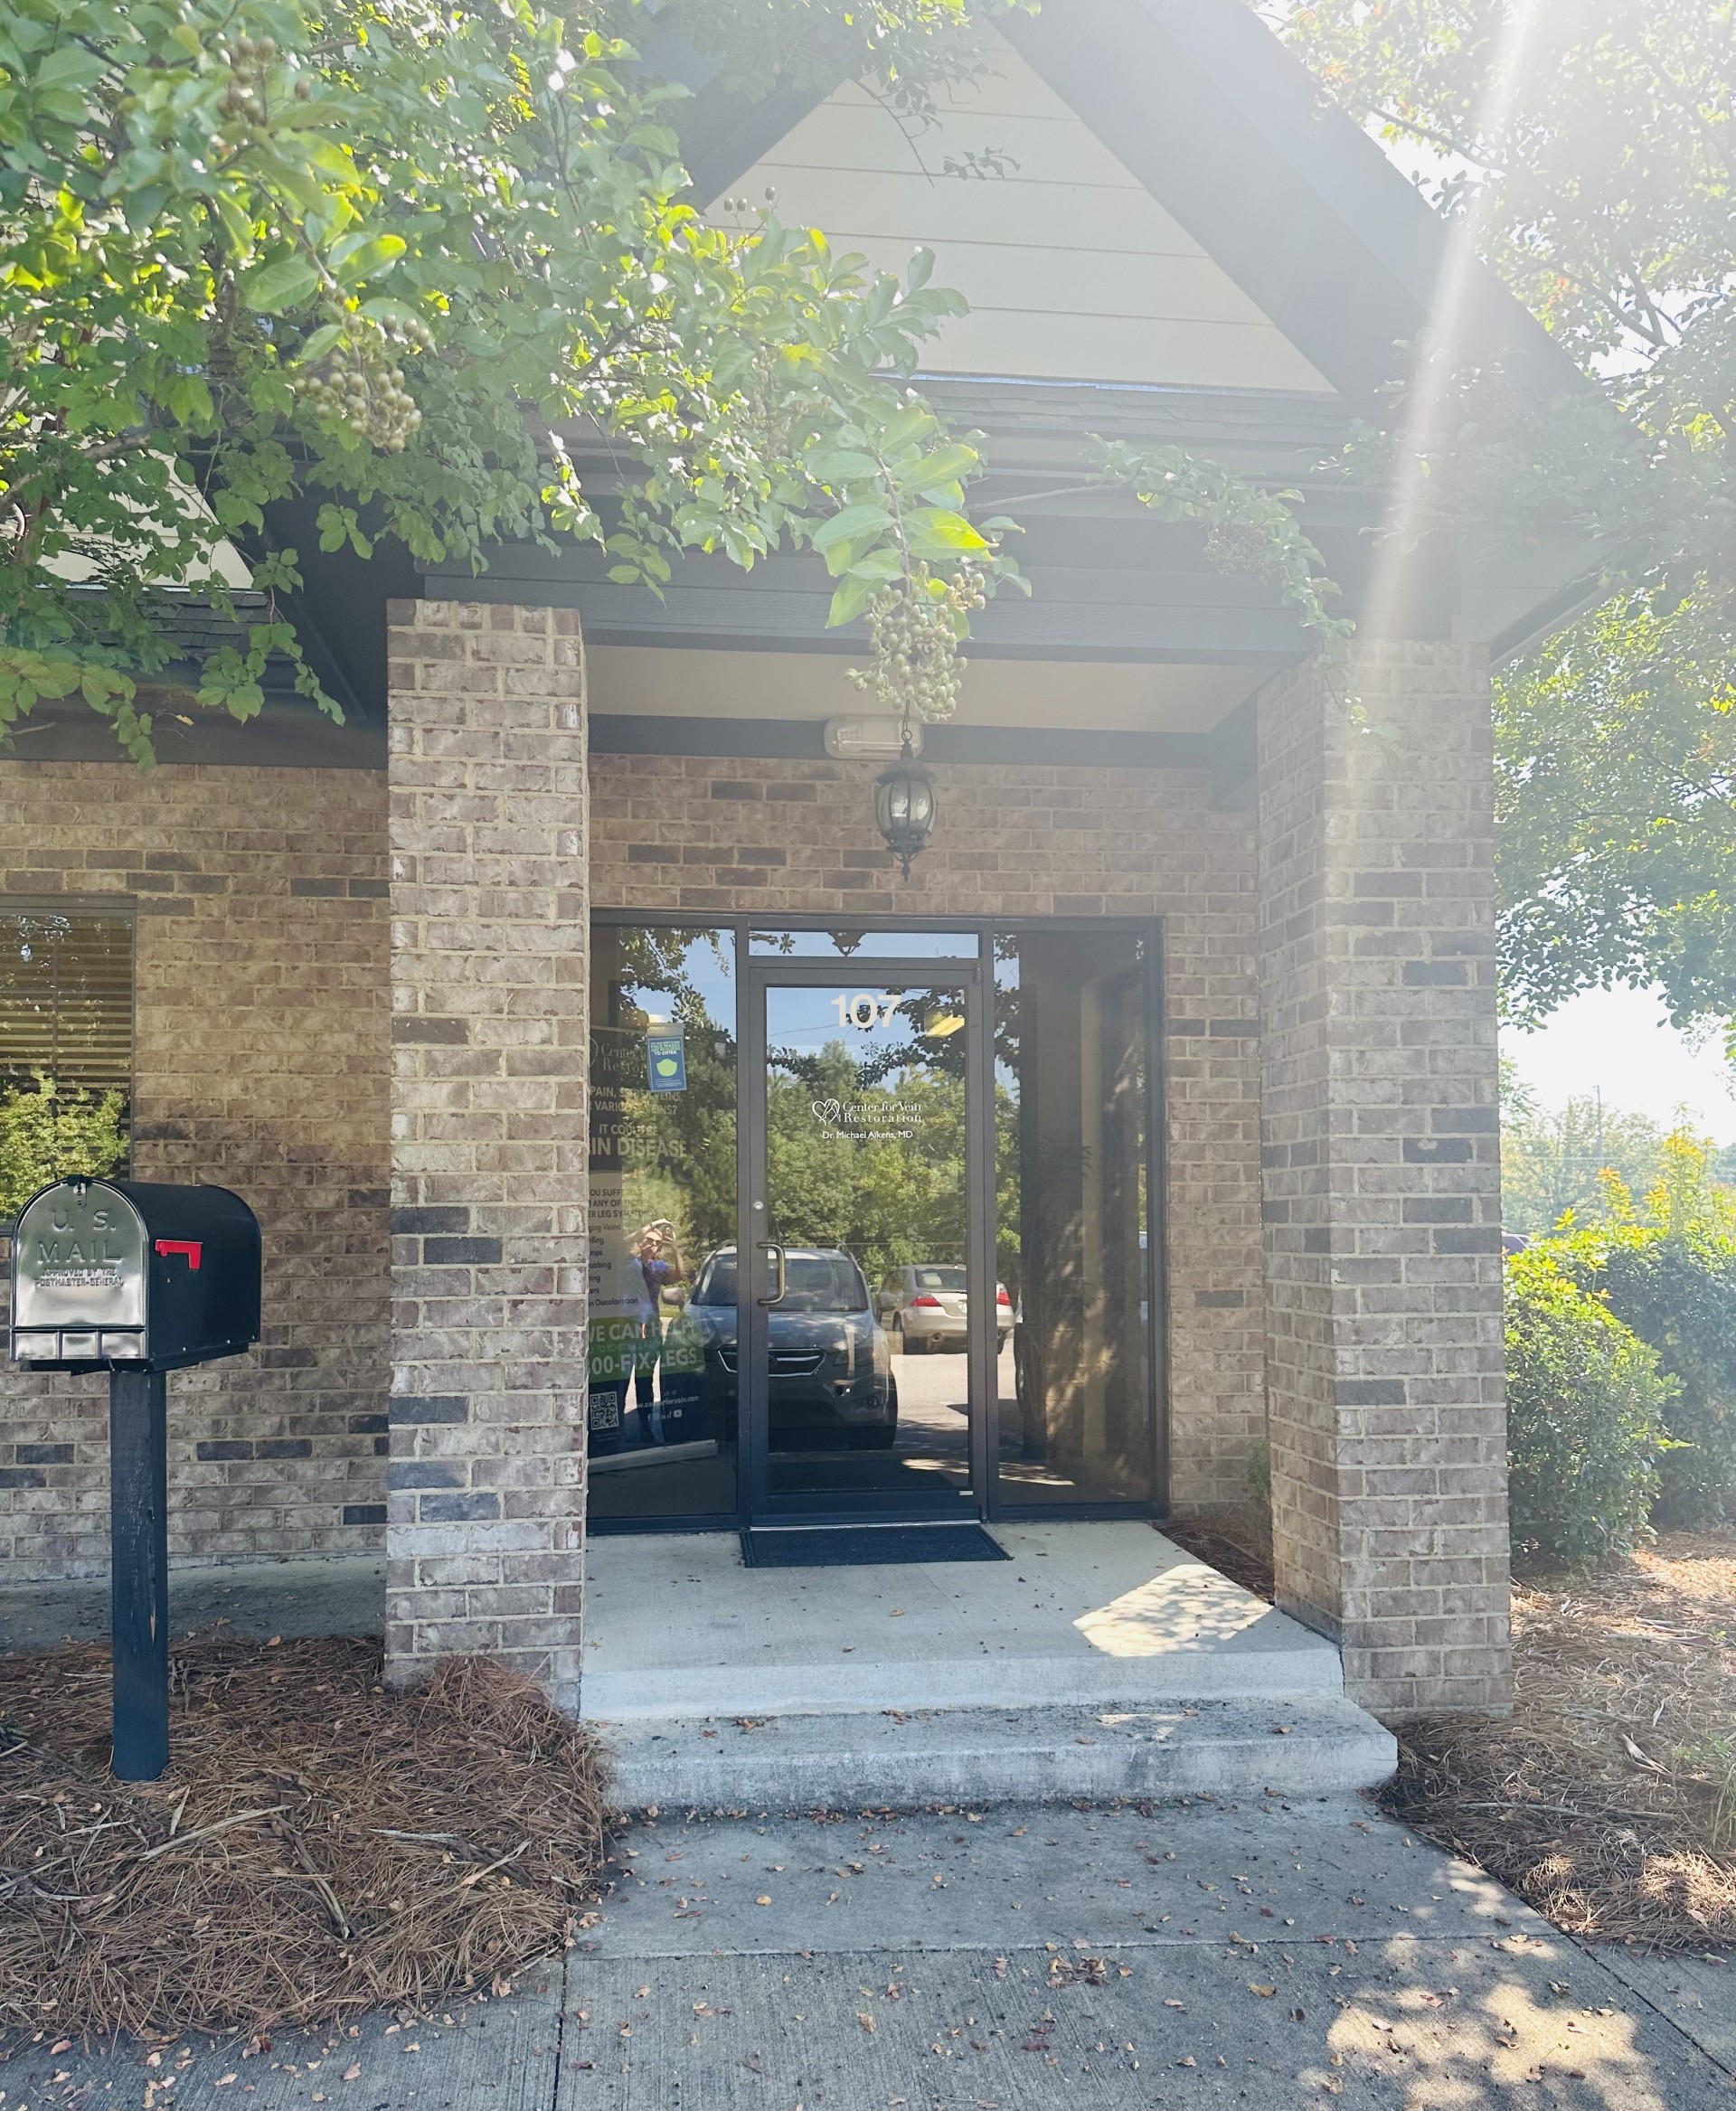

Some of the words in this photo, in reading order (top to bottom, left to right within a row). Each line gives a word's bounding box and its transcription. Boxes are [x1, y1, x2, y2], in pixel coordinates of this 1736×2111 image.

[831, 994, 901, 1029] 107
[843, 1101, 879, 1112] Center
[881, 1101, 897, 1112] for
[897, 1101, 921, 1112] Vein
[844, 1112, 922, 1123] Restoration
[599, 1124, 608, 1134] IT
[822, 1131, 835, 1139] Dr.
[836, 1130, 866, 1139] Michael
[898, 1130, 913, 1139] MD
[590, 1137, 610, 1156] IN
[618, 1138, 687, 1158] DISEASE
[37, 1239, 123, 1264] MAIL
[589, 1260, 611, 1269] obbing
[42, 1268, 84, 1277] APPROVED
[88, 1268, 98, 1277] BY
[100, 1268, 117, 1277] THE
[34, 1277, 125, 1287] POSTMASTER-GENERAL
[609, 1322, 646, 1342] CAN
